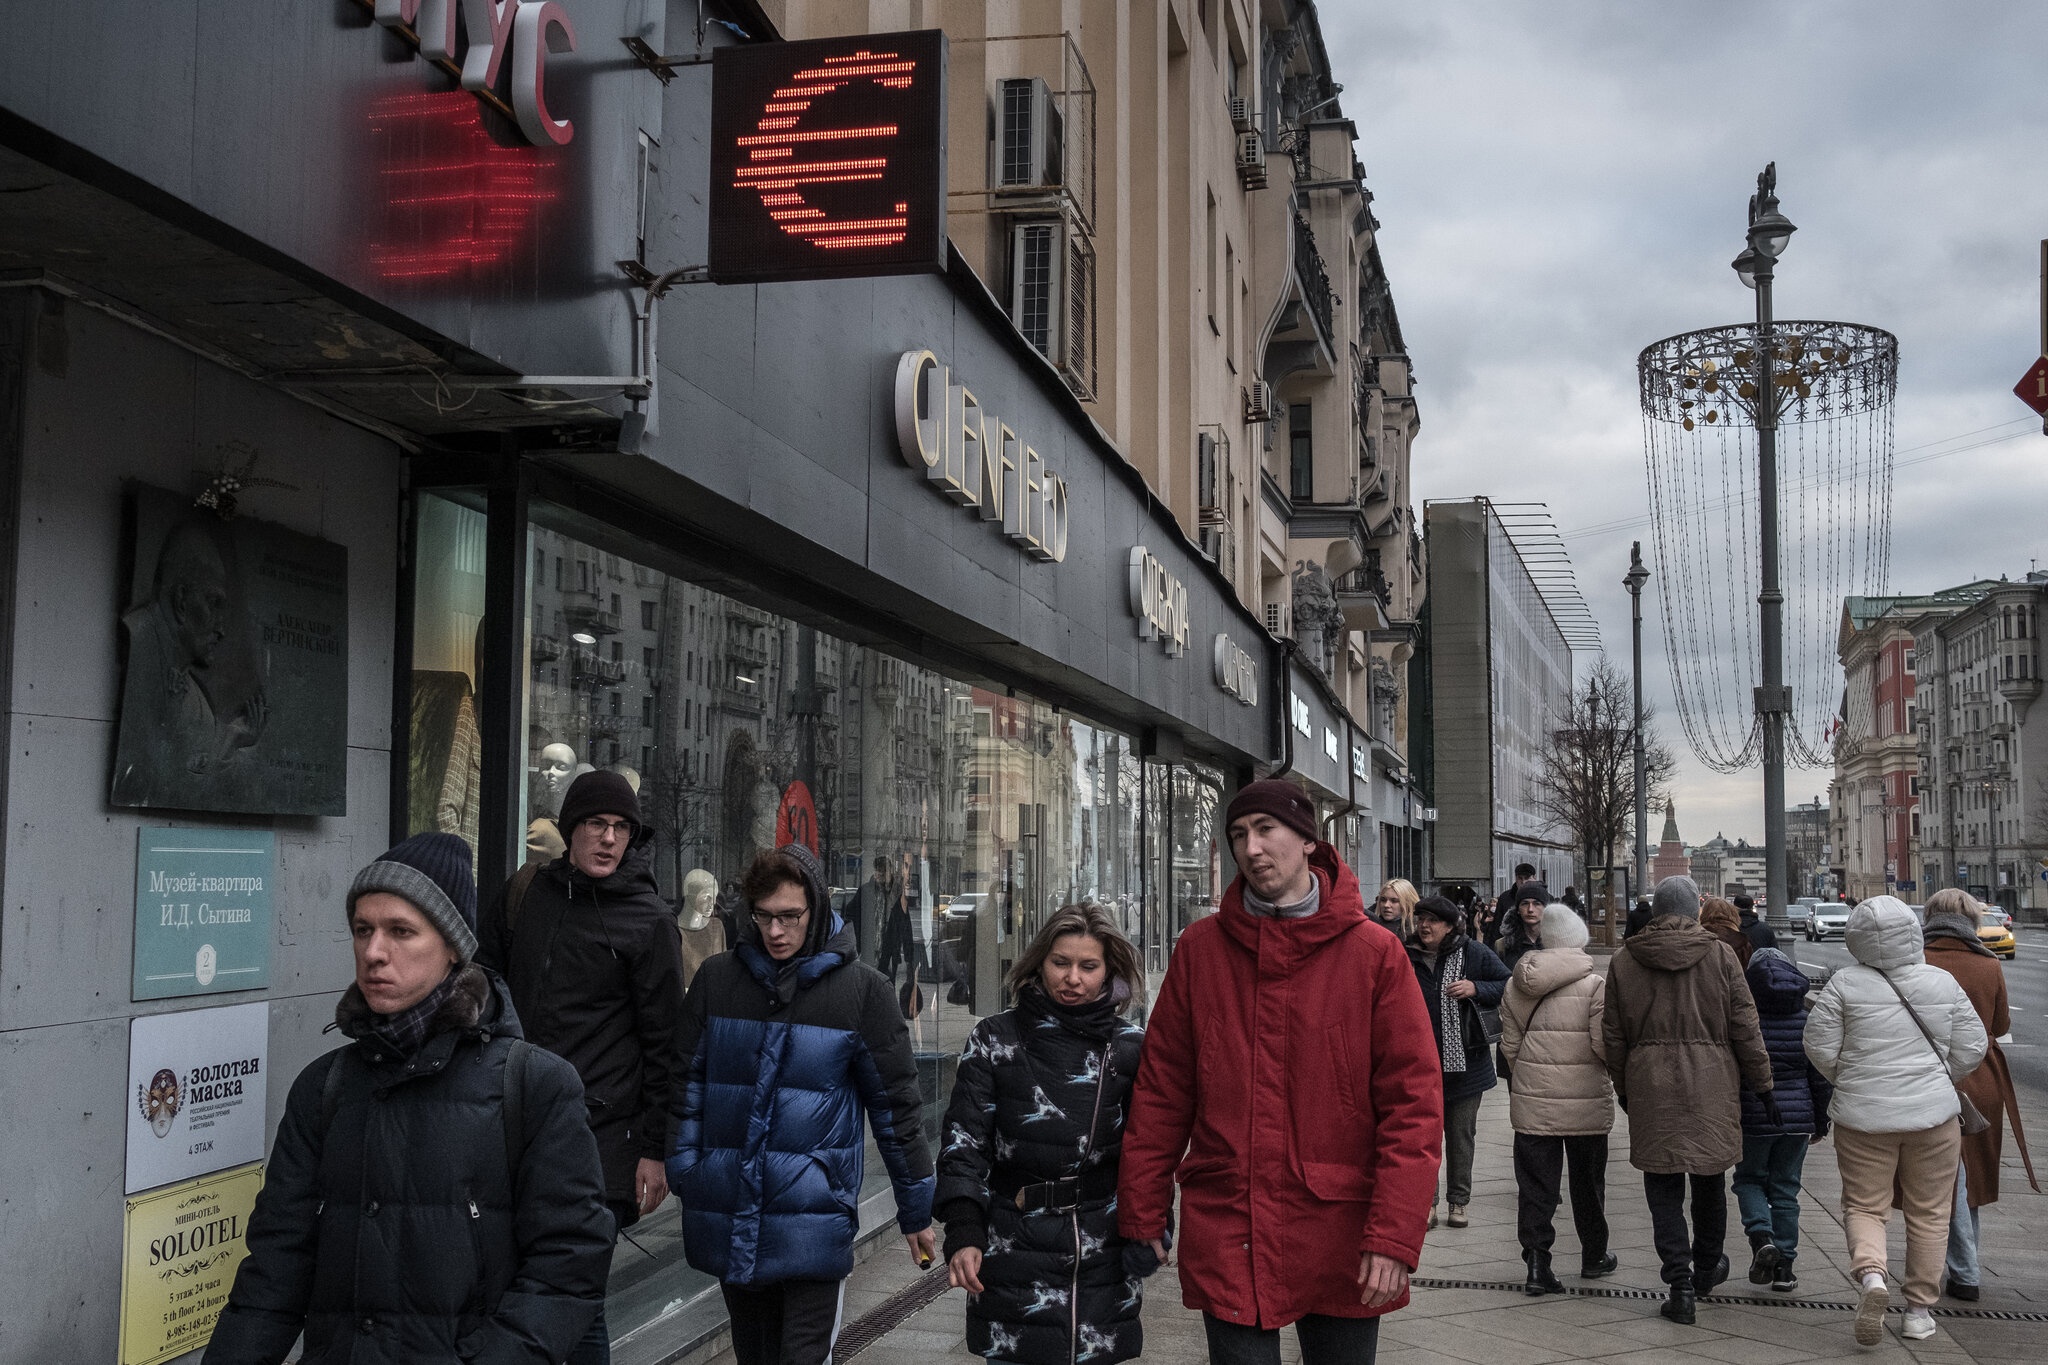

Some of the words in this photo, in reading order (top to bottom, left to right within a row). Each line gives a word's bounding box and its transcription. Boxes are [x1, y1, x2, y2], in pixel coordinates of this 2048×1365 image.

[1129, 545, 1190, 659] ОДЕЖДА
[149, 870, 263, 897] Музей-квартира
[160, 904, 193, 929] И.Д.
[198, 903, 251, 925] Сытина
[203, 952, 210, 967] 2
[189, 1104, 214, 1115] РОССИЙСКАЯ
[189, 1112, 215, 1123] ТЕАТРАЛЬНАЯ
[215, 1109, 231, 1118] ПРЕМИЯ
[193, 1120, 215, 1130] ФЕСТИВАЛЬ
[188, 1144, 193, 1156] 4
[194, 1140, 214, 1154] ЭТАЖ
[174, 1204, 221, 1226] МИНИ-ОТЕЛЬ
[149, 1214, 243, 1267] SOLOTEL
[169, 1292, 175, 1304] 5
[175, 1287, 194, 1302] этаж
[195, 1282, 204, 1296] 24
[204, 1278, 221, 1292] часа
[163, 1313, 168, 1325] 5
[169, 1310, 177, 1322] th
[178, 1304, 196, 1320] floor
[196, 1300, 205, 1313] 24
[206, 1294, 226, 1309] hours
